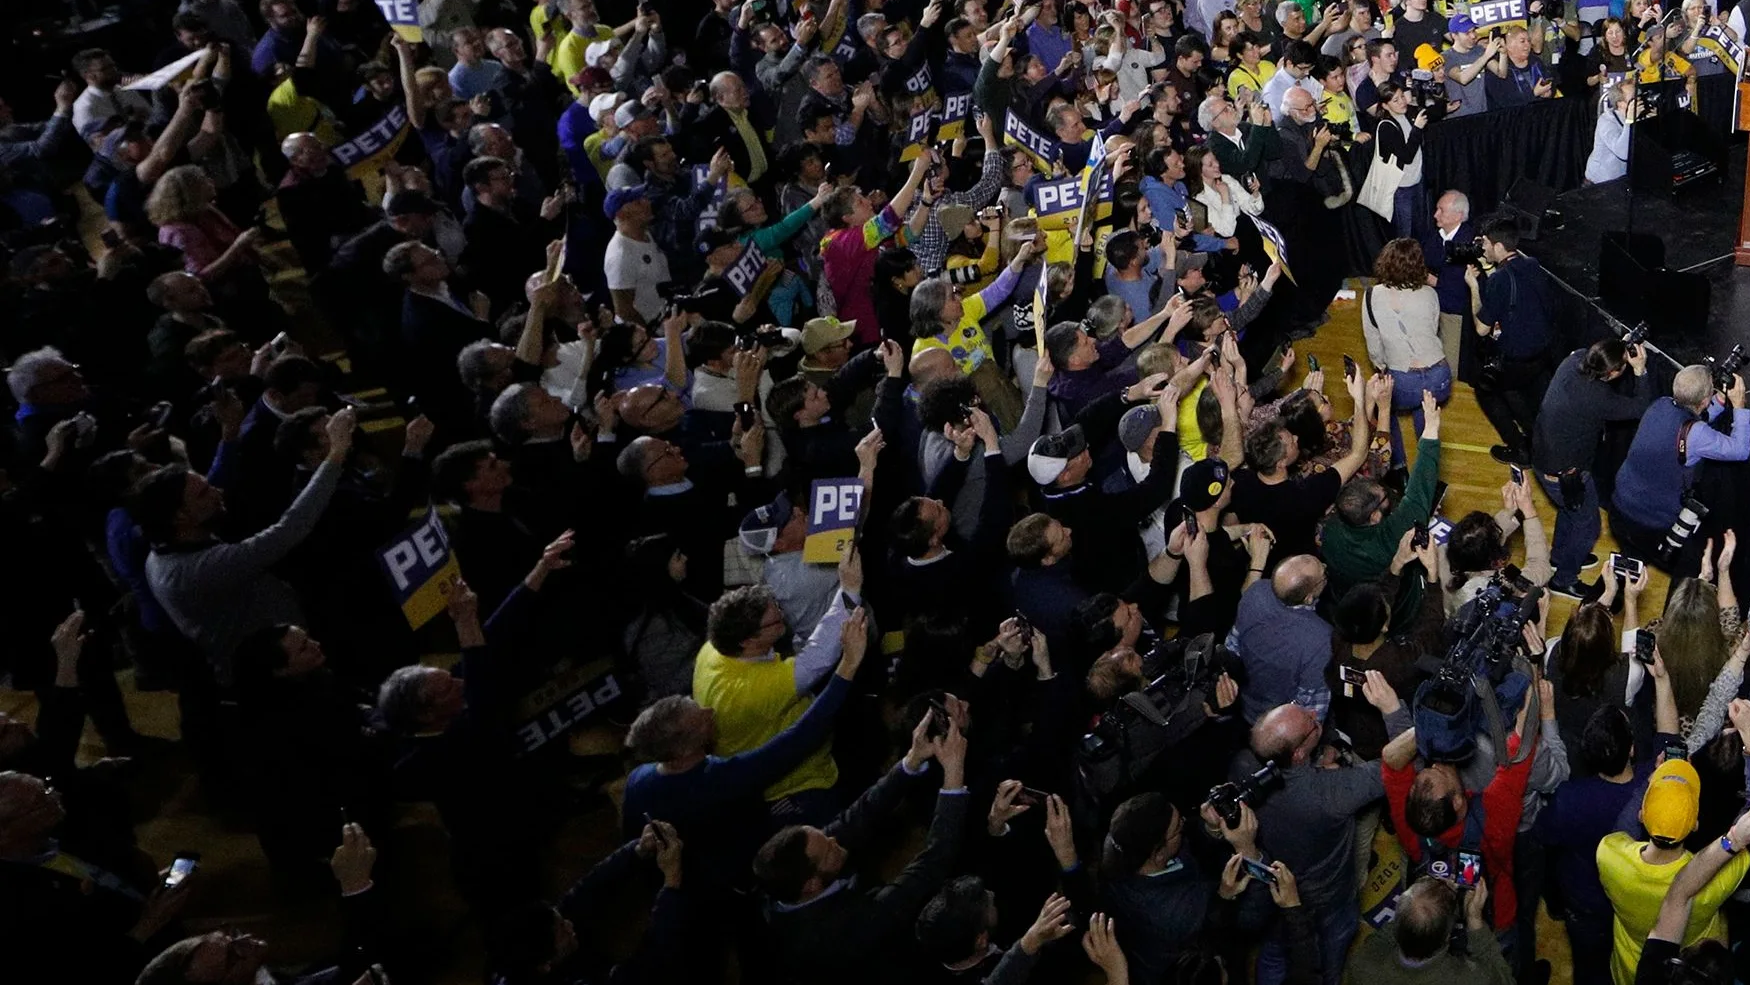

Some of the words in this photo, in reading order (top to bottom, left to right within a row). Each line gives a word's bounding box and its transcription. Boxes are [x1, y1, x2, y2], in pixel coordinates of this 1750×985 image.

[1471, 0, 1523, 24] PETE
[907, 67, 931, 92] PET
[946, 94, 971, 120] PET
[332, 107, 406, 165] PETE
[910, 112, 930, 140] PE
[1007, 118, 1051, 159] PETE
[728, 240, 768, 295] PETE
[814, 485, 864, 525] PET
[517, 674, 621, 752] PETE
[1372, 861, 1399, 892] 2020
